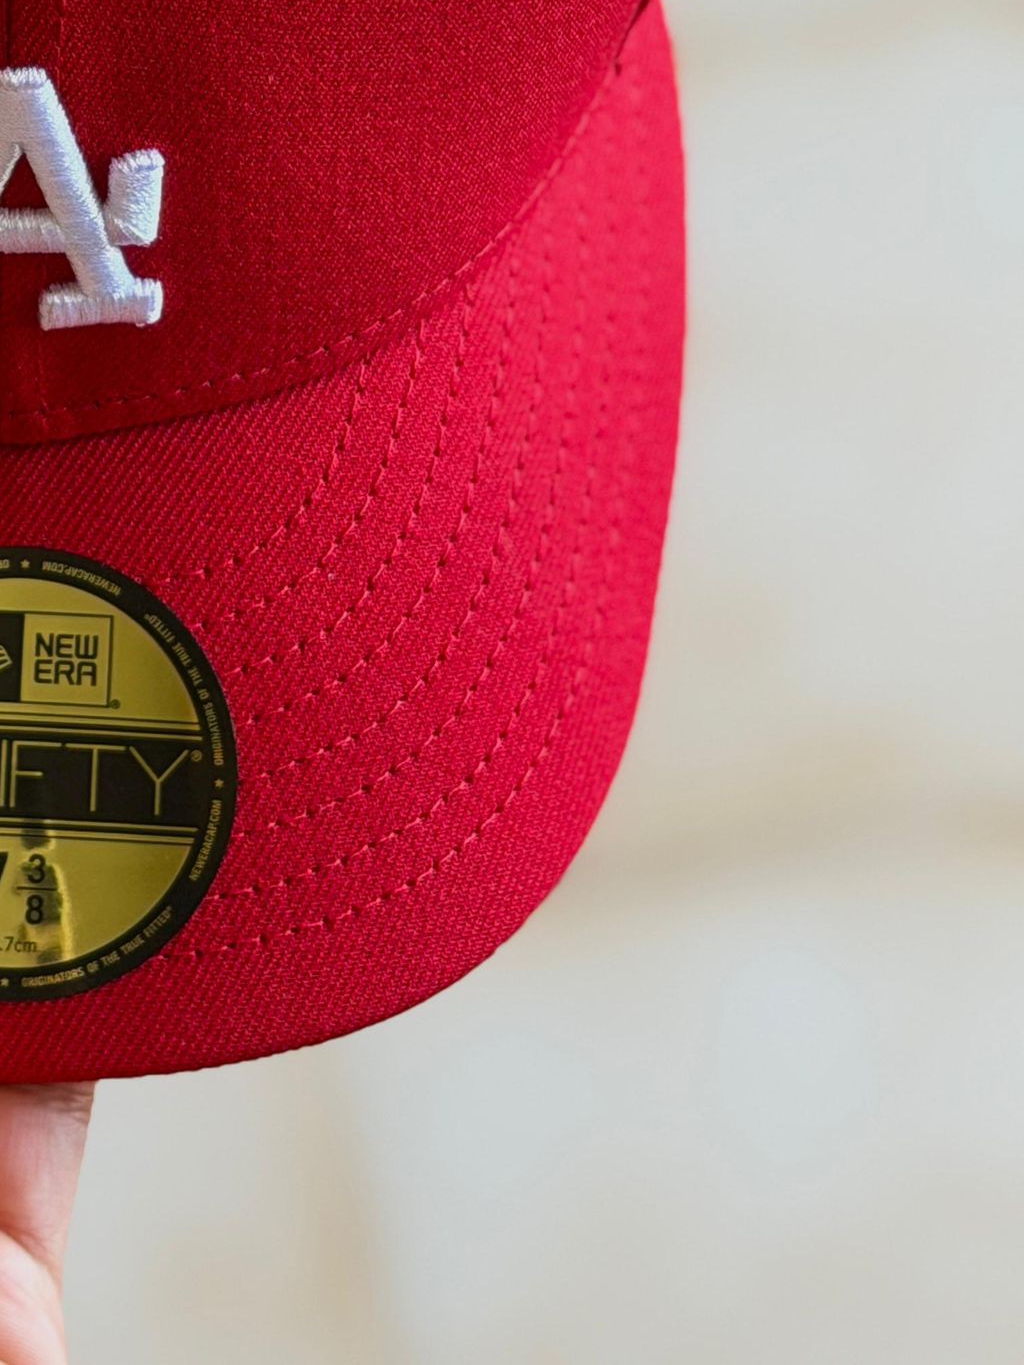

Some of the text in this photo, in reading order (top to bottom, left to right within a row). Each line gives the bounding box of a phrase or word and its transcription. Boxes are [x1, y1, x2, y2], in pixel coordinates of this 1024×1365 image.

[34, 633, 99, 660] NEW
[33, 659, 98, 687] ERA
[99, 950, 121, 966] THE
[119, 937, 145, 955] TRUE
